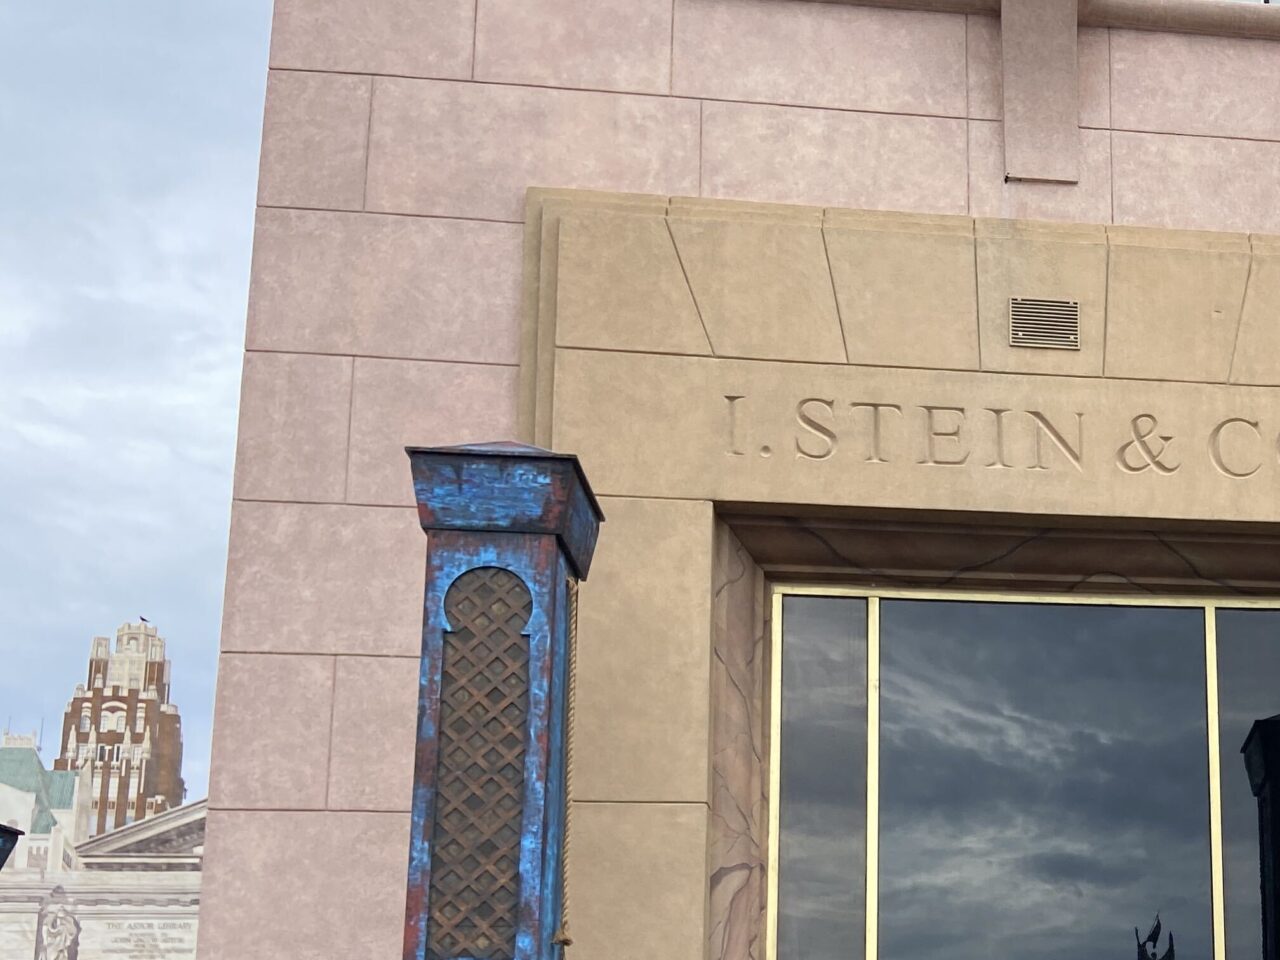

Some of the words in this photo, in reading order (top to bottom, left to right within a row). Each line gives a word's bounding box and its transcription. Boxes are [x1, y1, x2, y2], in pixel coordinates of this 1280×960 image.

[723, 394, 772, 458] I.
[795, 397, 1084, 473] STEIN
[1115, 413, 1181, 476] &
